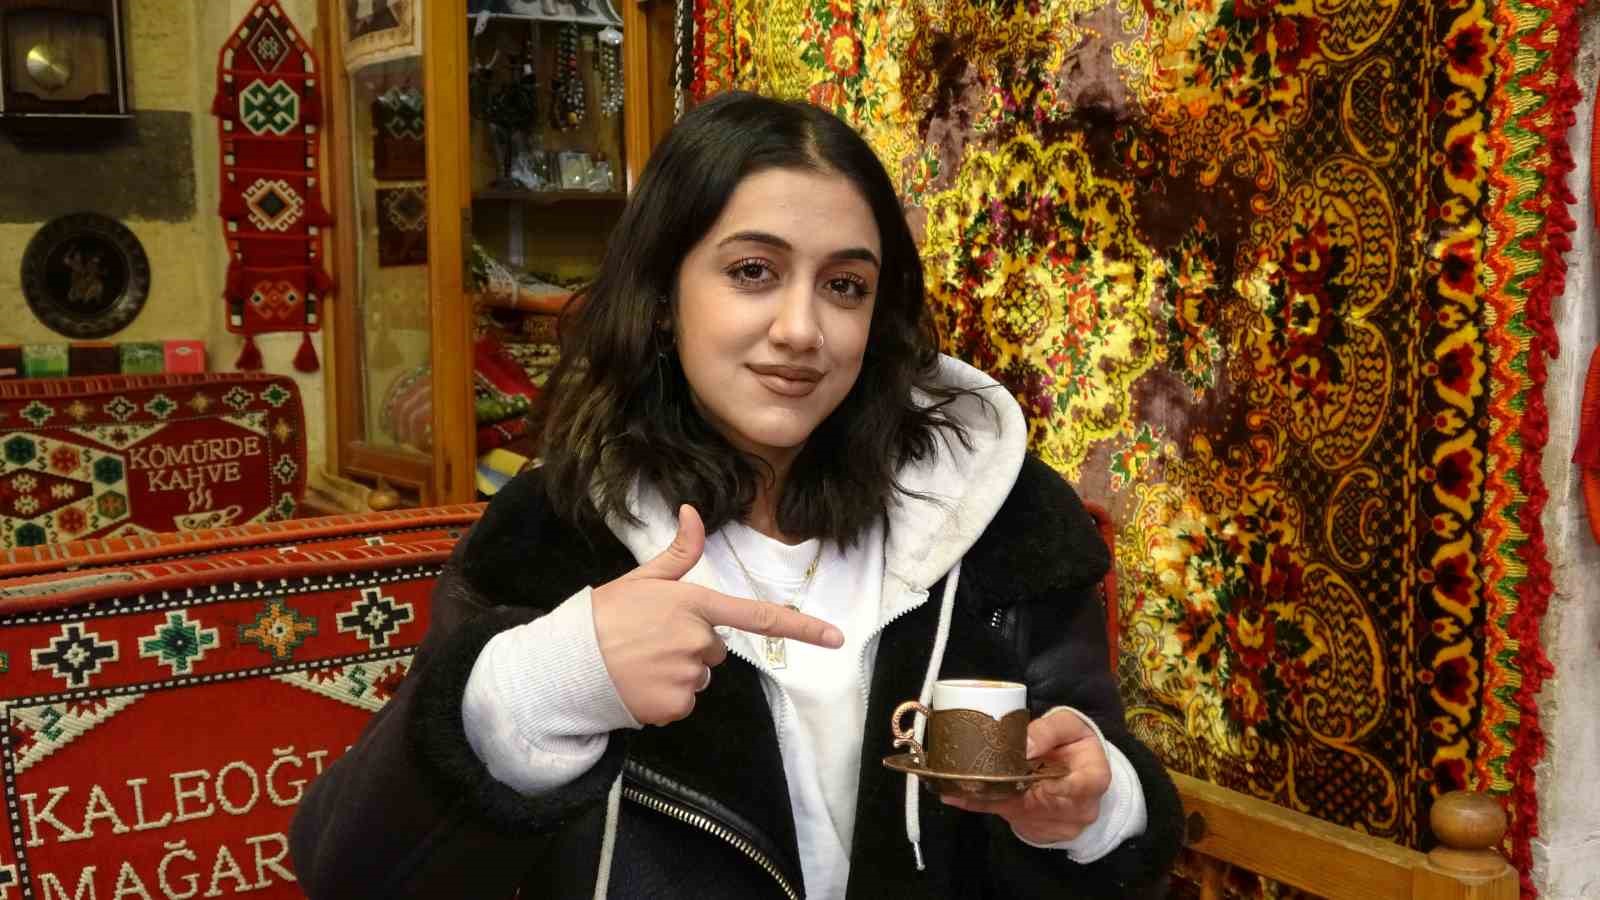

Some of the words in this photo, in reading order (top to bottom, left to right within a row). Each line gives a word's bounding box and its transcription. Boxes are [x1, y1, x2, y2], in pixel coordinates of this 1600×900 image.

[128, 436, 260, 469] KÖMÜRDE
[147, 461, 241, 492] KAHVE
[20, 745, 352, 847] KALEOĞ
